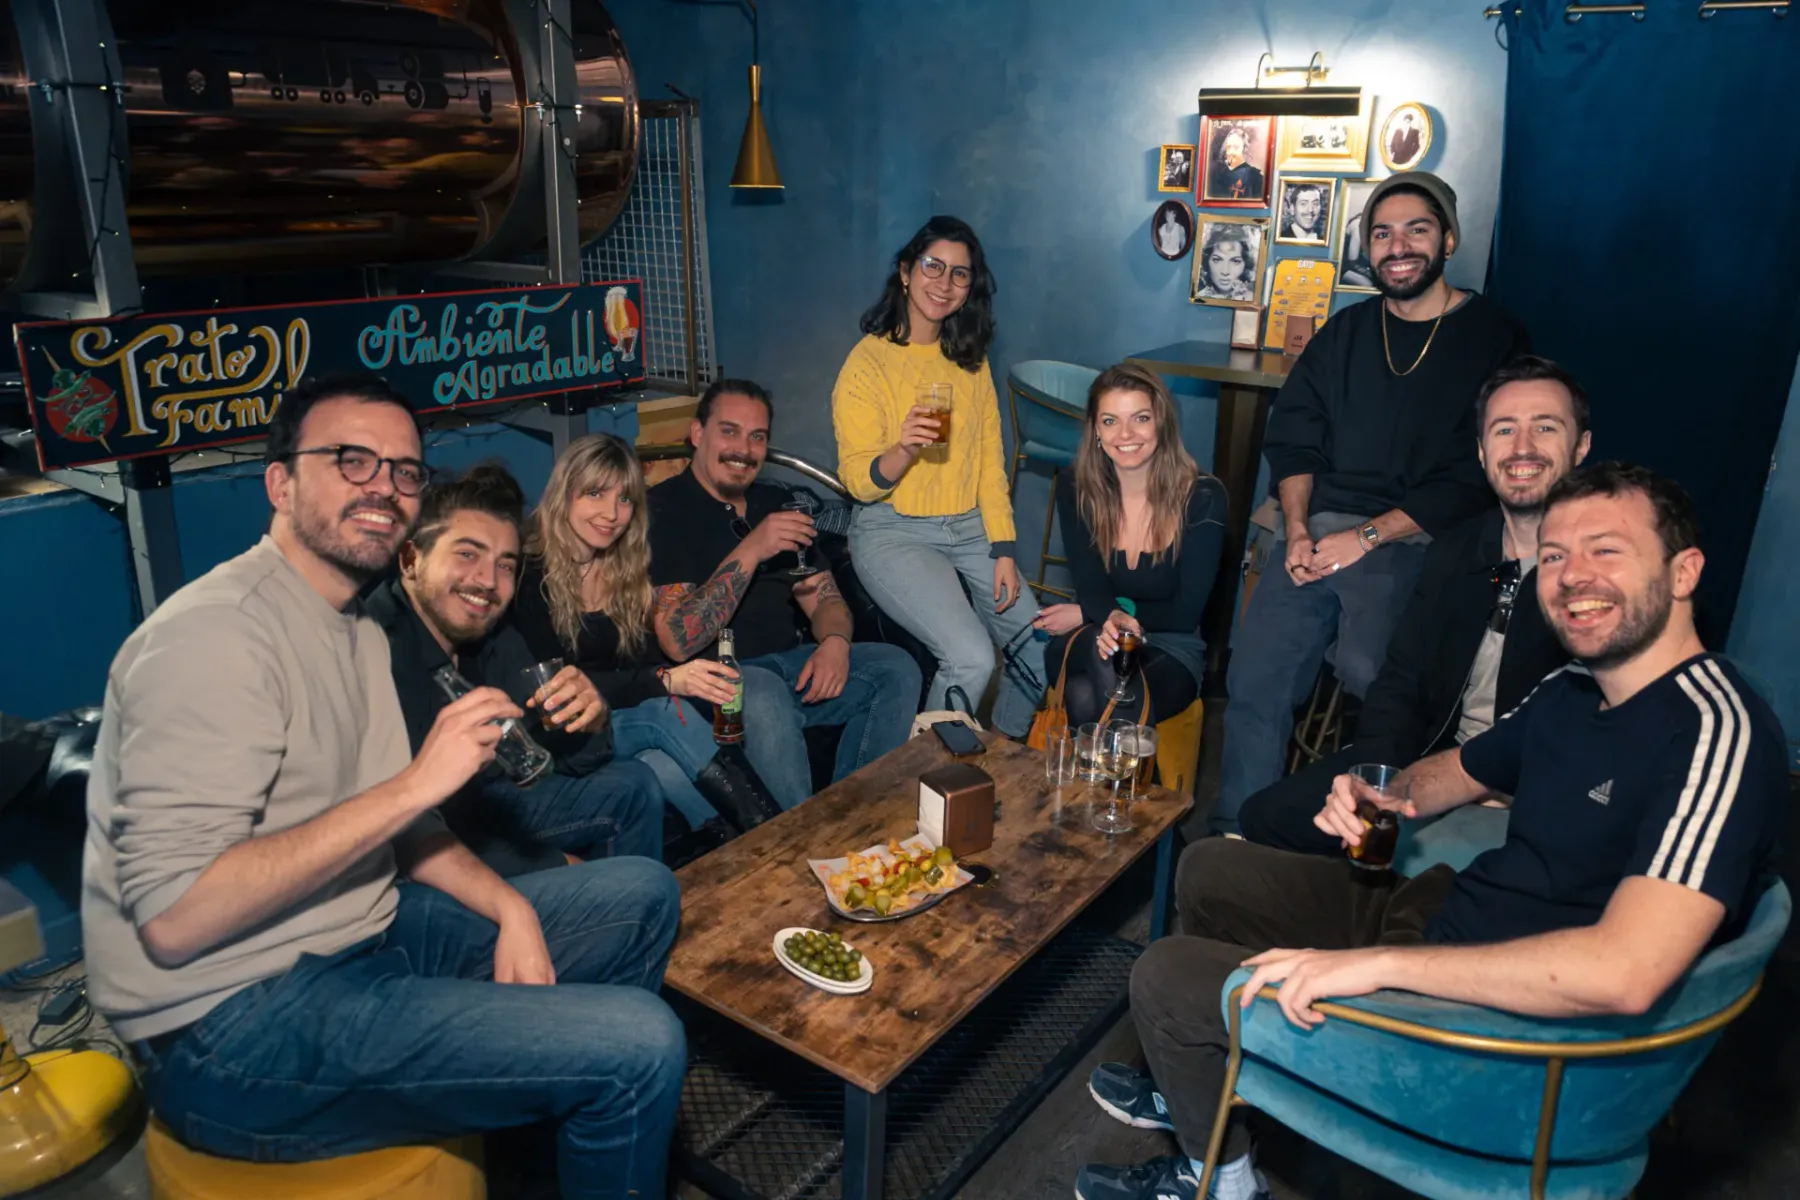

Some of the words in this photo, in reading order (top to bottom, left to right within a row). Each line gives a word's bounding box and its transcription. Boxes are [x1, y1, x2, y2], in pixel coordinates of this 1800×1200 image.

[70, 317, 257, 438] Trato
[358, 292, 572, 370] Ambiente
[433, 310, 615, 404] Agradable
